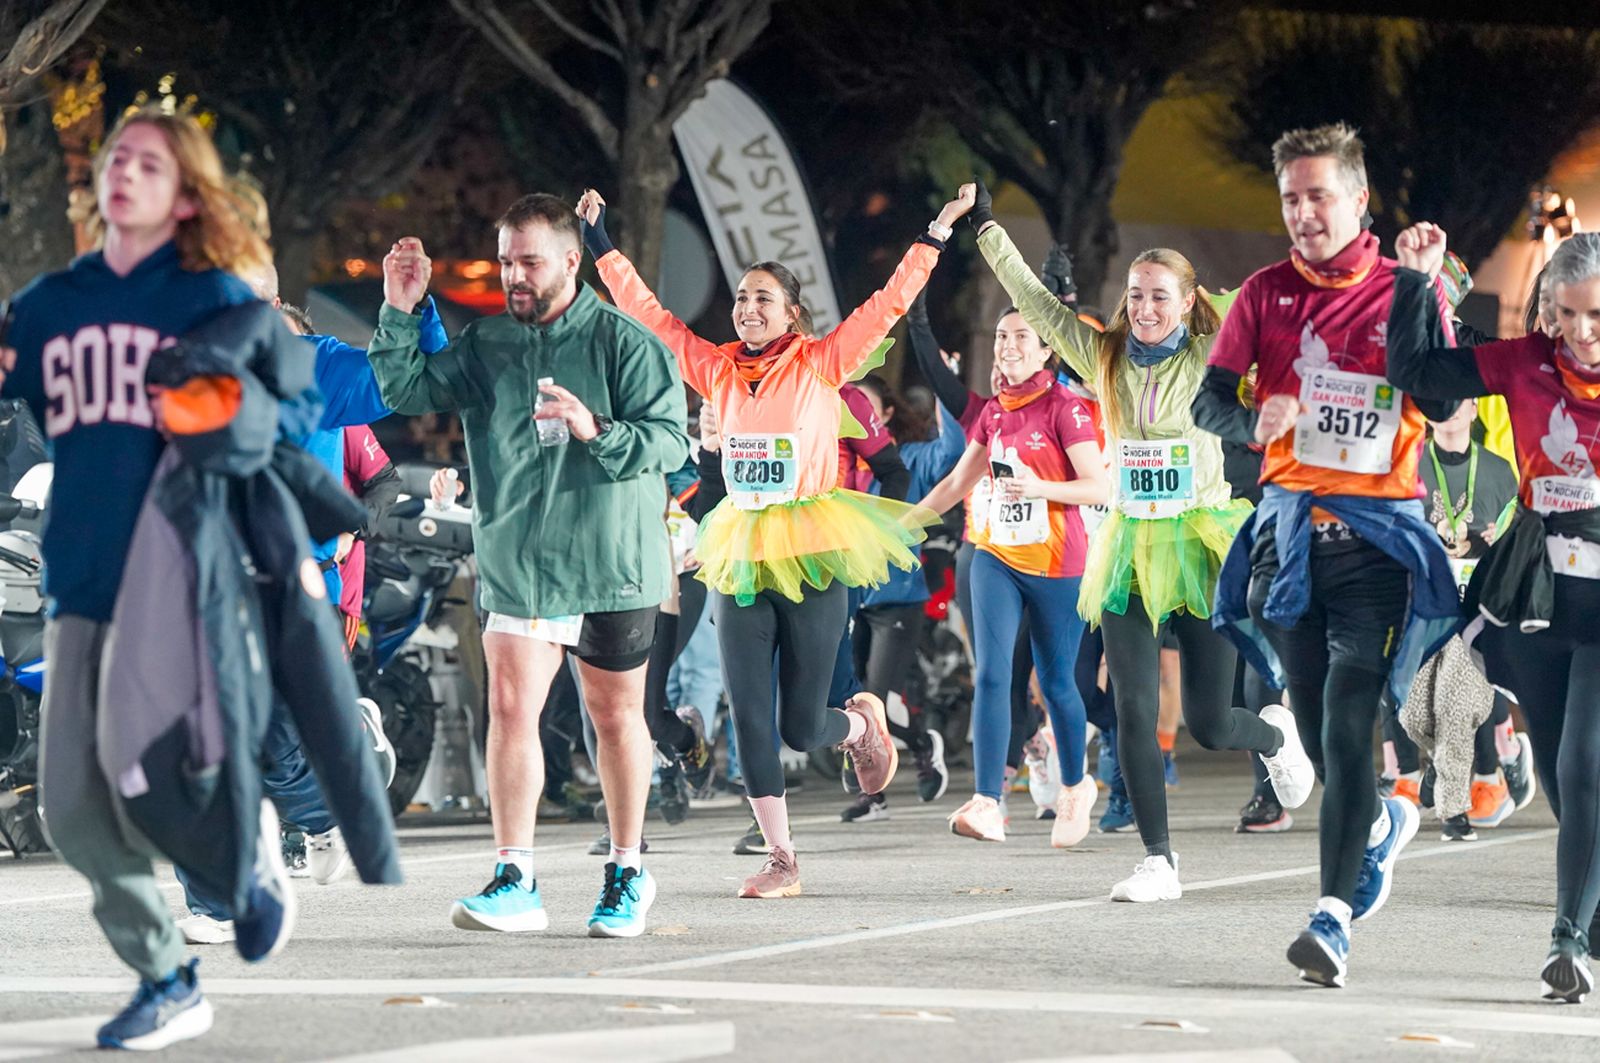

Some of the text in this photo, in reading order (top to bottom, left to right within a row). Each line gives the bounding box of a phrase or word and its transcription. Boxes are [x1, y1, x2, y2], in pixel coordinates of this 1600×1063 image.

[42, 322, 177, 438] SOH
[1326, 383, 1366, 395] NOCHE DE
[1312, 391, 1329, 402] SAN
[1318, 405, 1379, 439] 3512
[738, 441, 756, 449] NOCHE
[730, 451, 743, 459] SAN
[1153, 449, 1163, 457] DE
[1124, 459, 1136, 467] SAN
[734, 461, 785, 484] 8809
[1130, 468, 1179, 493] 8810
[1554, 487, 1580, 499] NOCHE
[1543, 495, 1559, 507] SAN
[999, 502, 1032, 523] 6237
